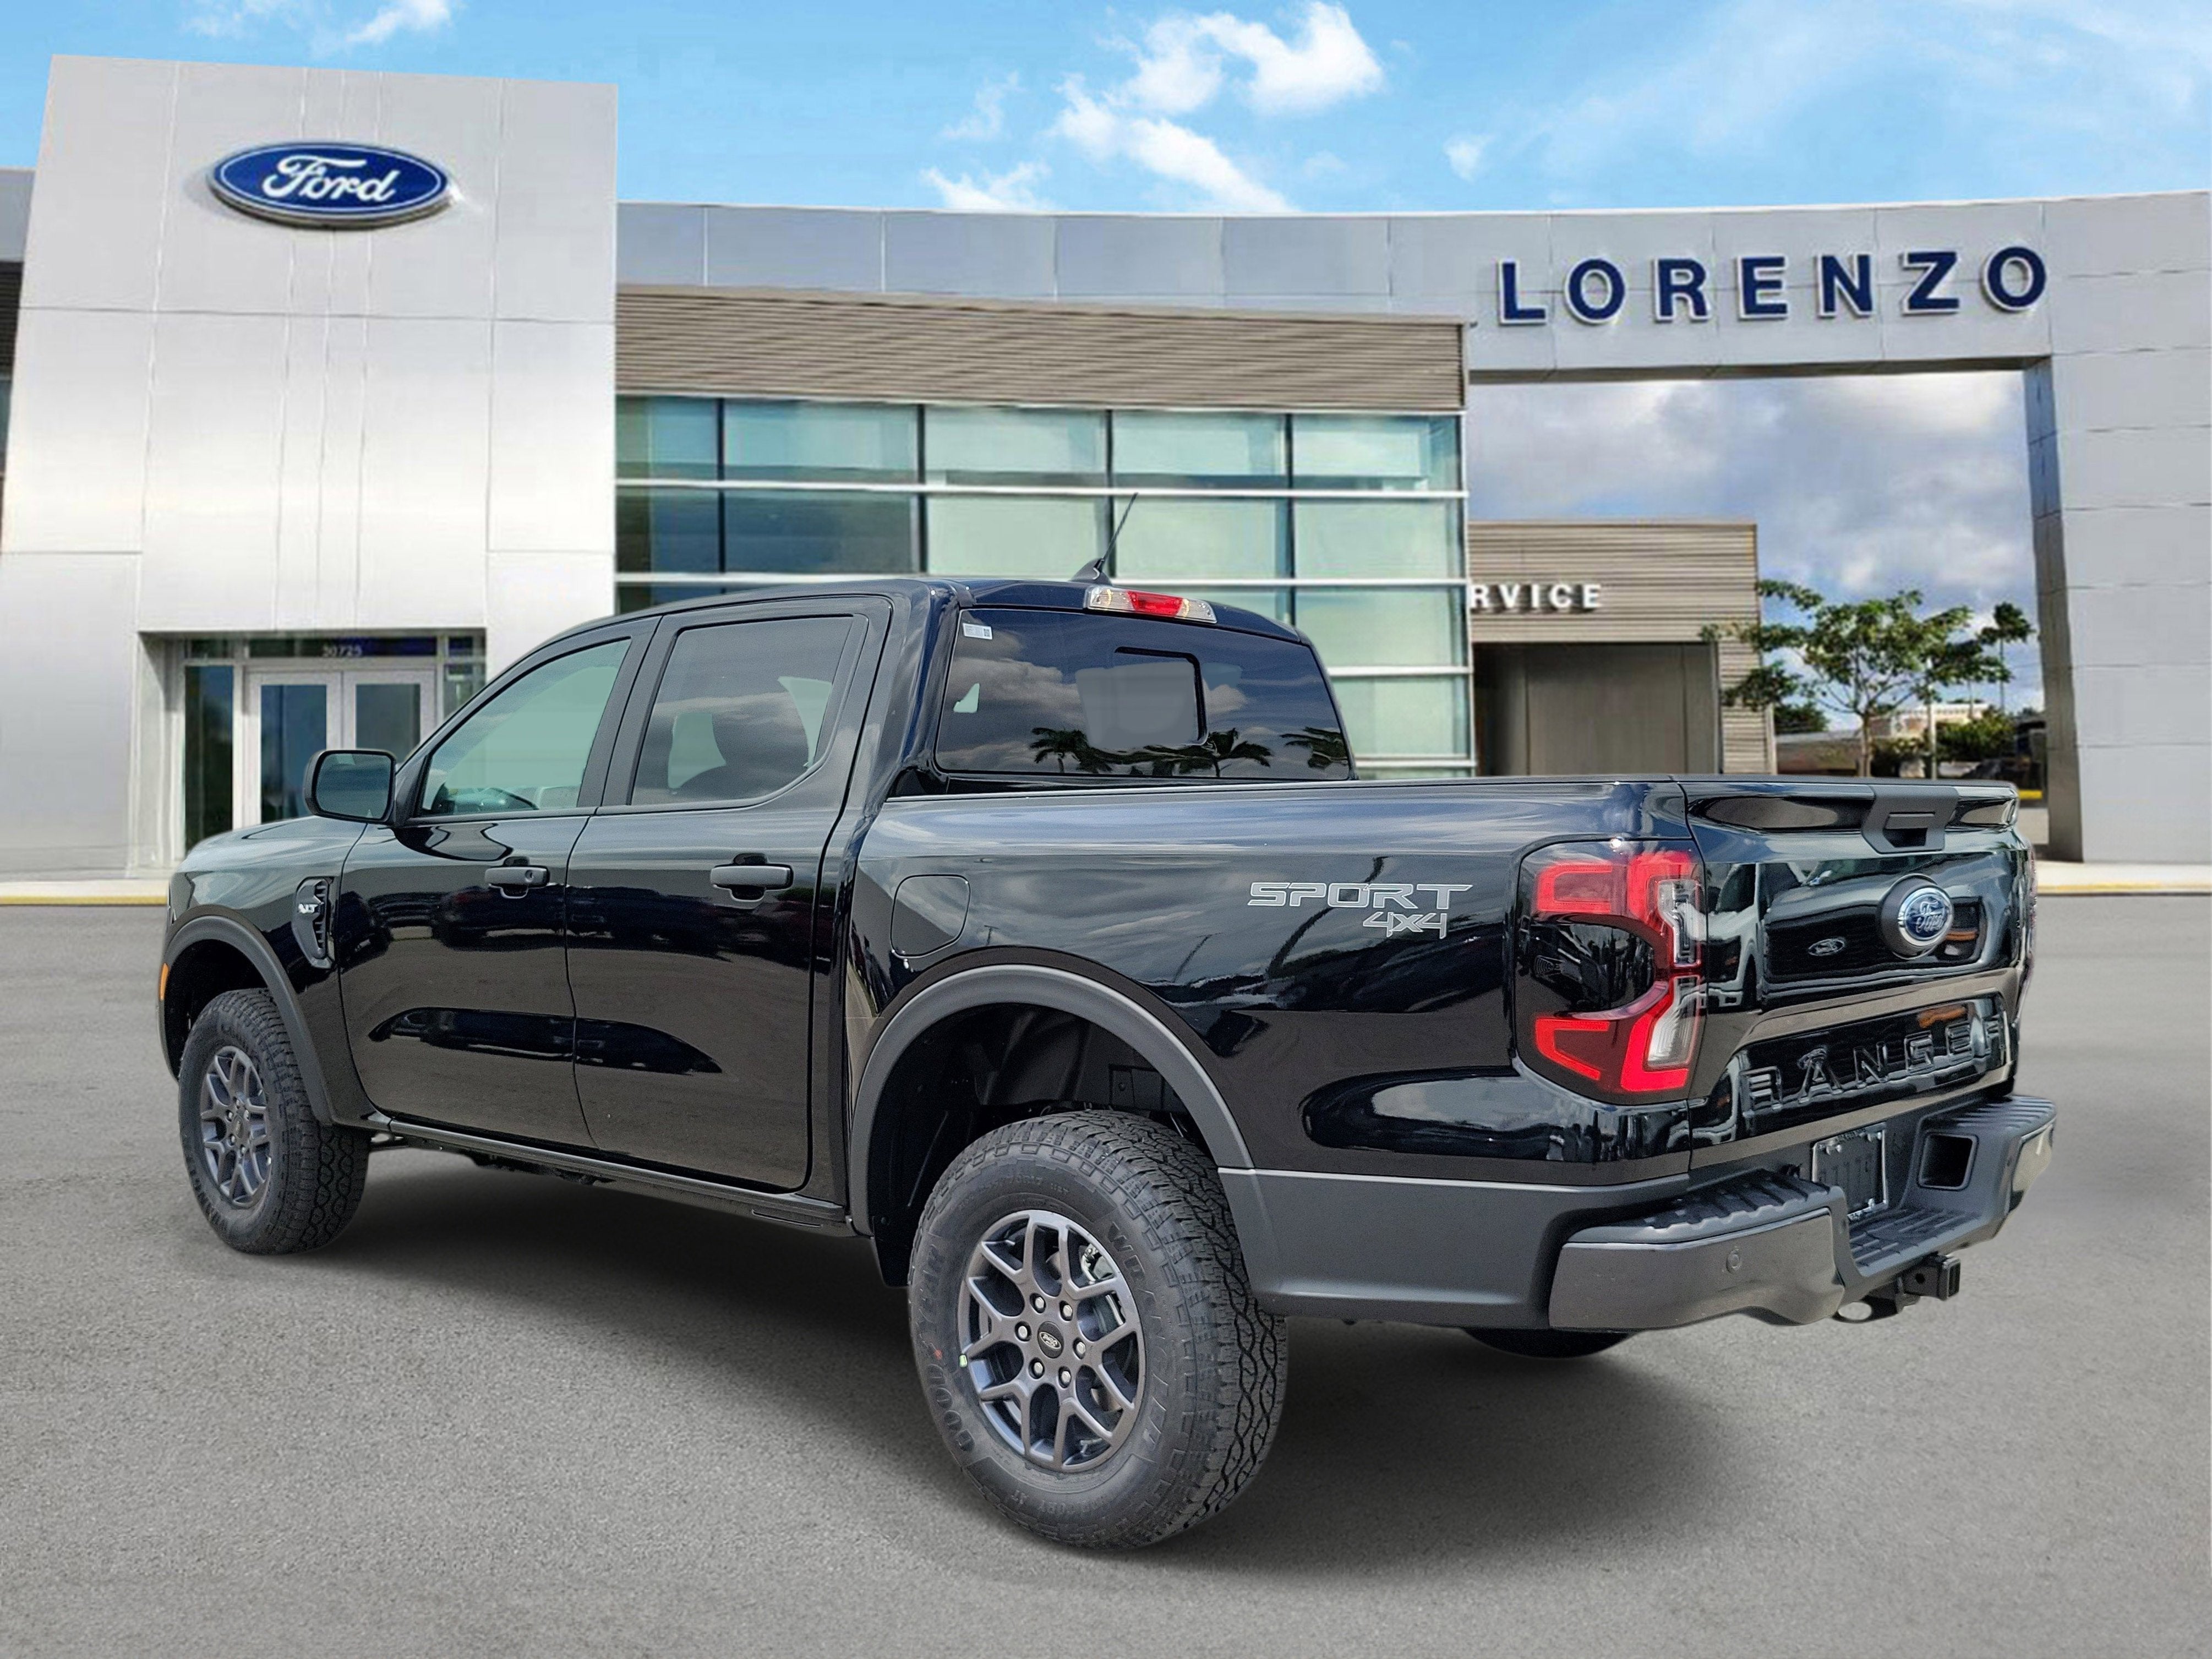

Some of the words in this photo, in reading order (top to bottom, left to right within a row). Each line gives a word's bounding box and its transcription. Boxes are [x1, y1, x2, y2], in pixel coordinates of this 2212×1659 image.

[262, 154, 401, 201] Ford
[1496, 245, 2049, 325] LORENZO
[1248, 882, 1474, 910] SPORT
